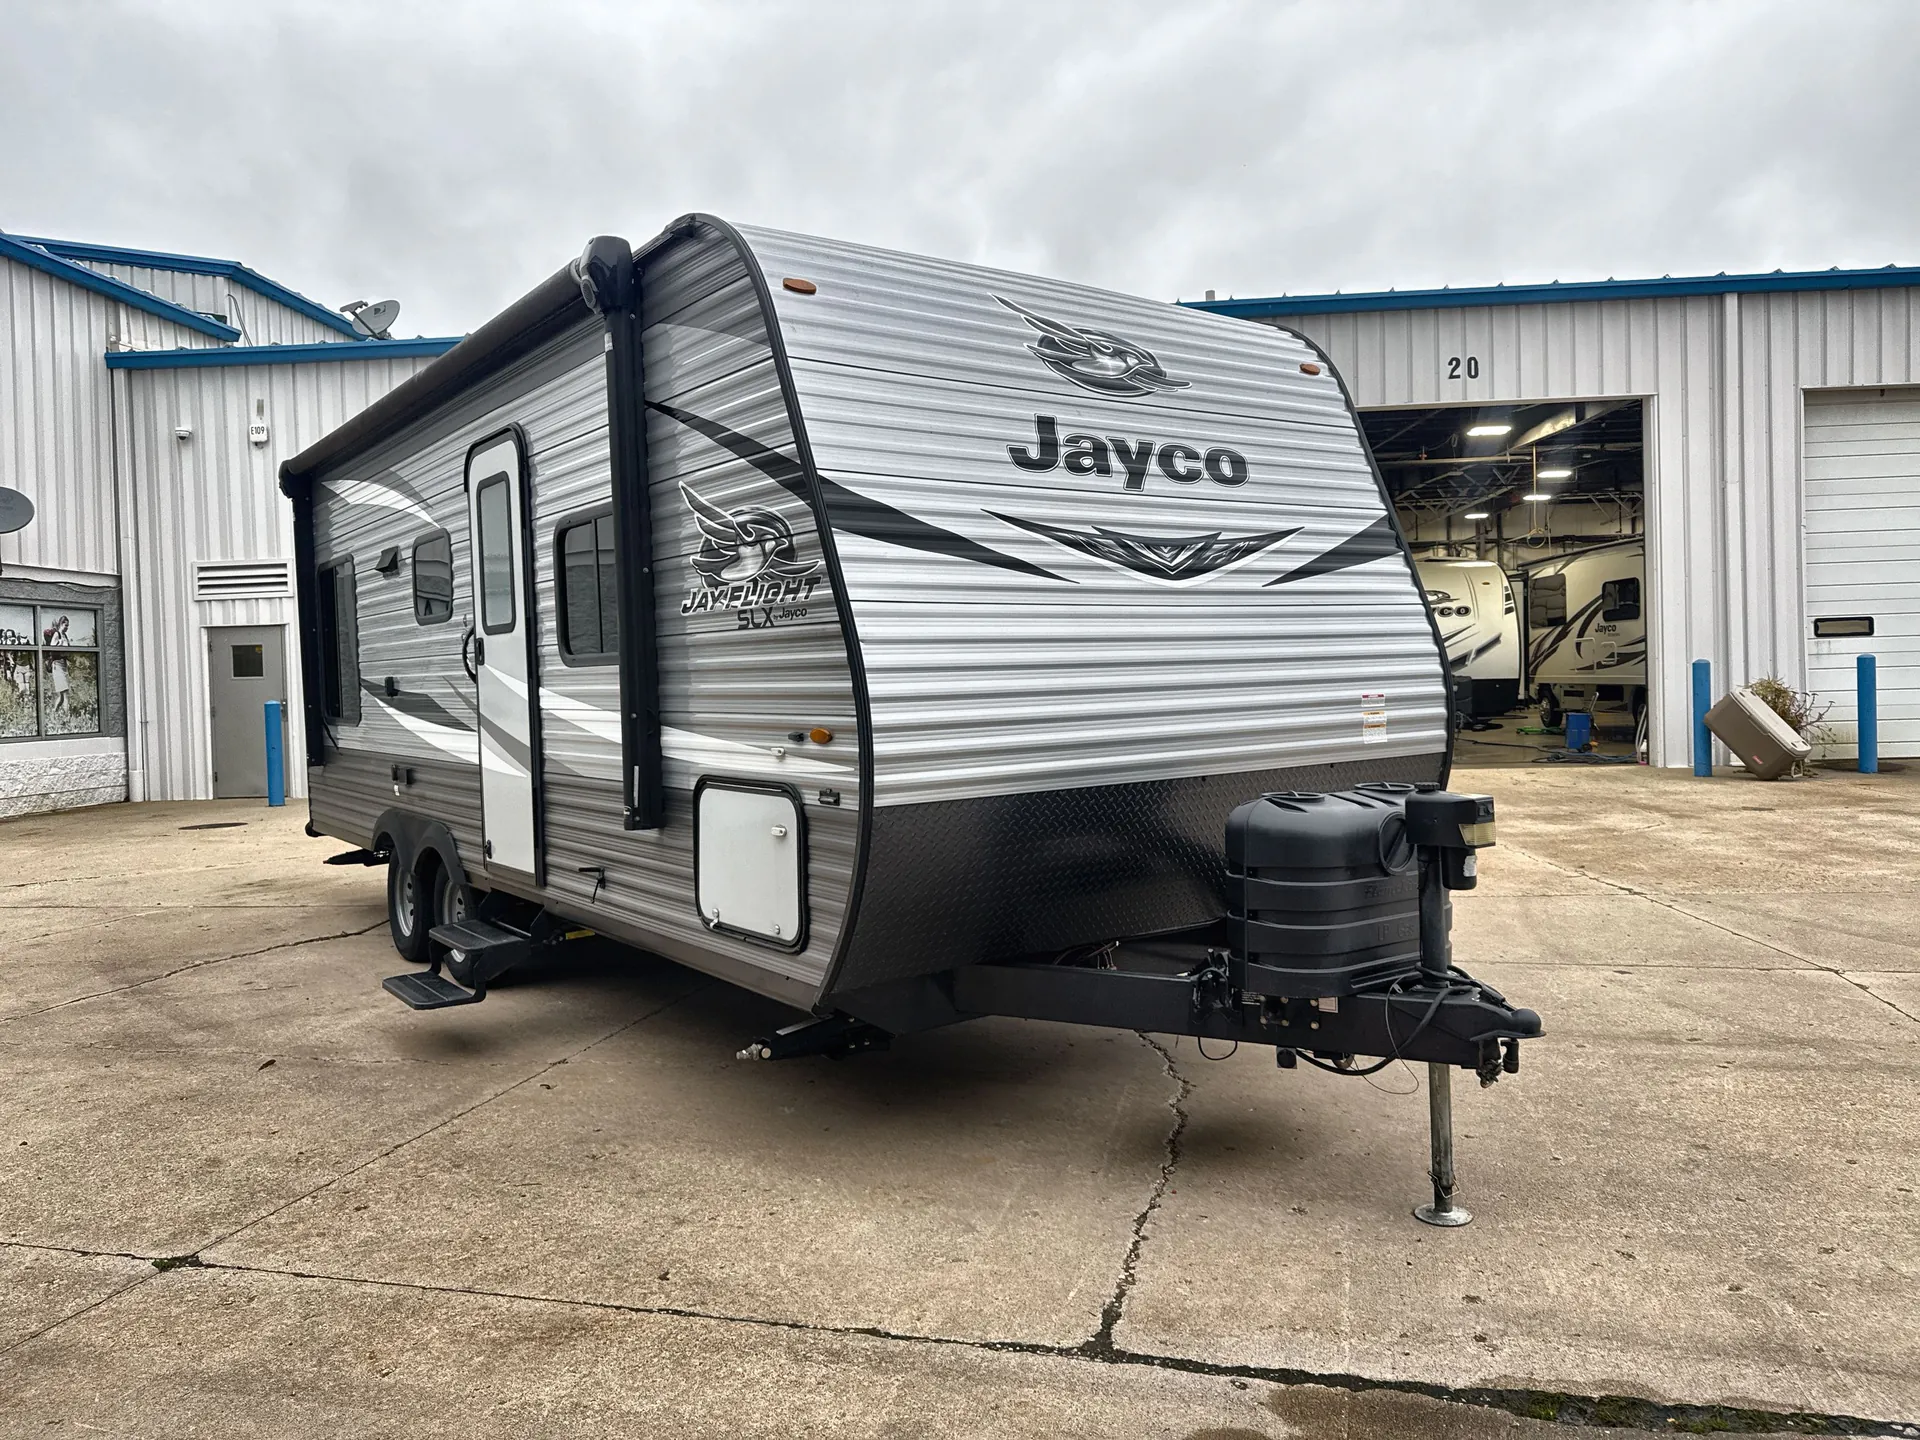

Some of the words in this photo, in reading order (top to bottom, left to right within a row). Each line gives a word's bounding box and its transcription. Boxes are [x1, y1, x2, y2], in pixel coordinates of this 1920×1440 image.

[1447, 356, 1480, 380] 20
[250, 426, 265, 435] E109
[1005, 413, 1251, 492] Jayco
[681, 586, 725, 615] JAY
[724, 575, 822, 611] FLIGHT
[737, 606, 775, 630] SLX
[778, 607, 807, 621] Jayco
[1594, 622, 1617, 635] Jayco
